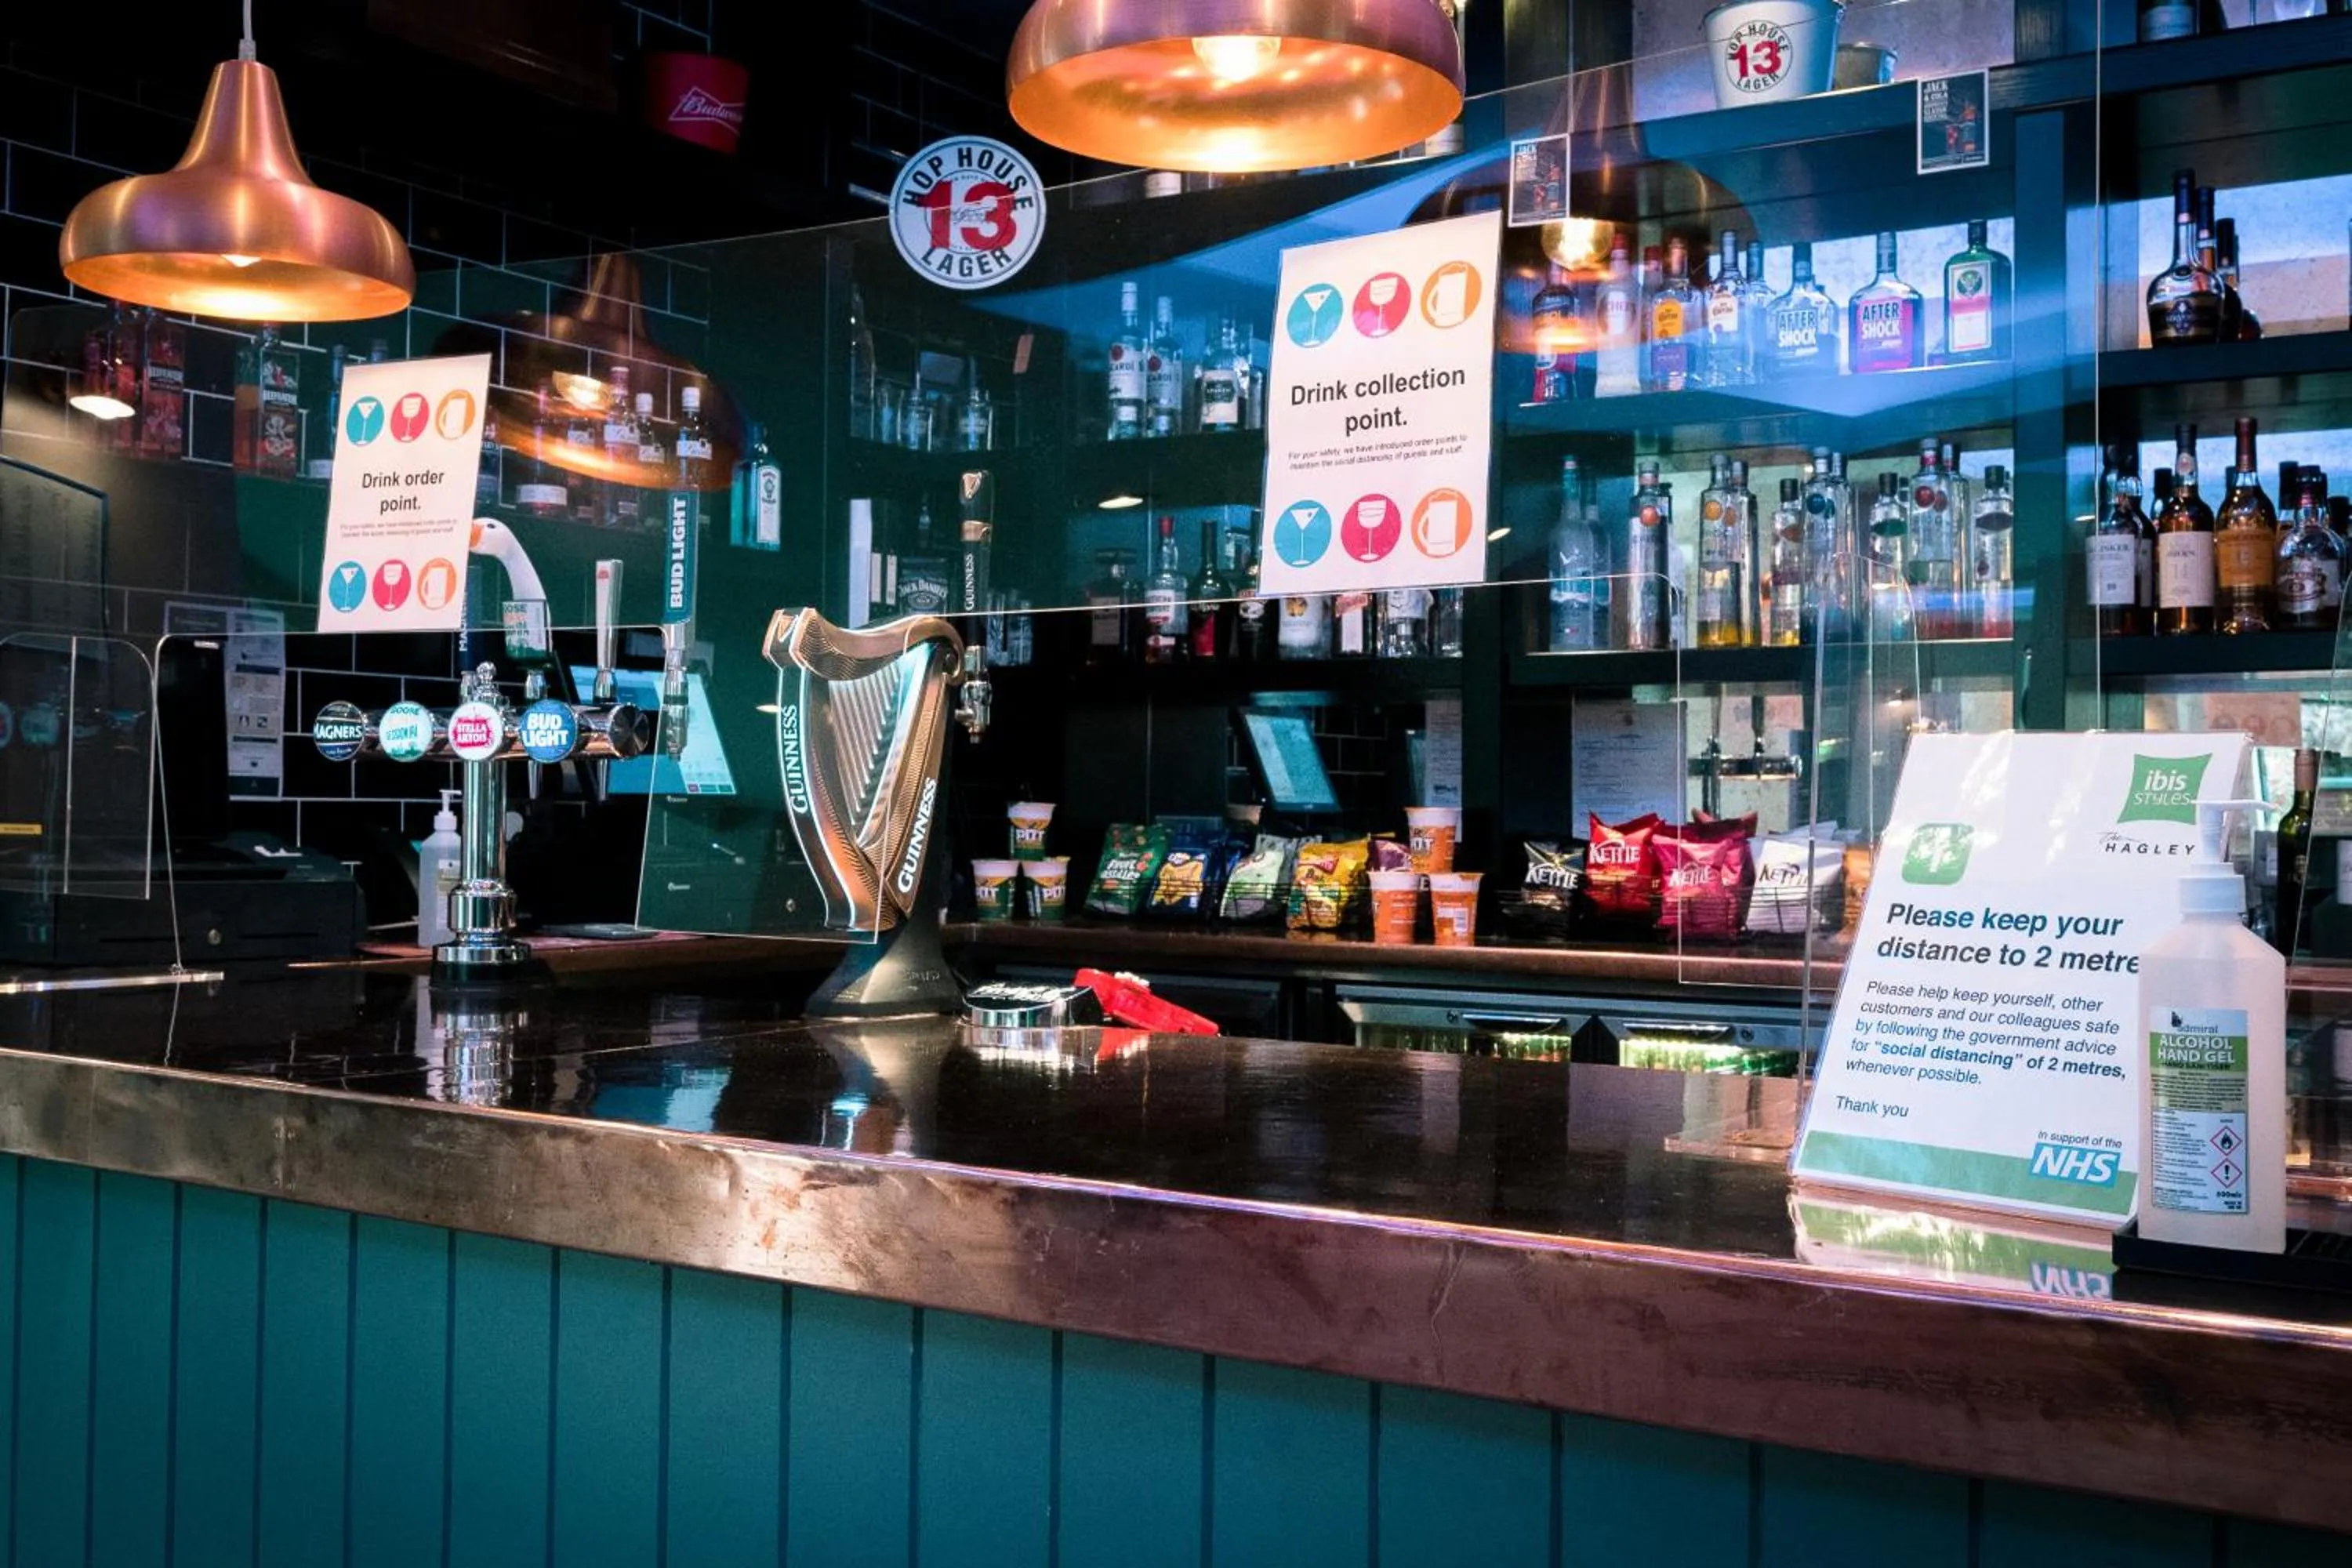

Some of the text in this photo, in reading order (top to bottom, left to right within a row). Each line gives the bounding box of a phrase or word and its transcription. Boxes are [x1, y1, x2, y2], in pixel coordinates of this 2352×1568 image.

[1734, 41, 1781, 77] 13
[903, 147, 1033, 211] HOP HOUSE
[916, 180, 1017, 251] 13
[921, 248, 1012, 278] LAGER
[1779, 311, 1817, 330] AFTER
[1863, 301, 1900, 321] AFTER
[1778, 328, 1817, 348] SHOCK
[1861, 319, 1900, 339] SHOCK
[1291, 368, 1465, 405] Drink collection
[1345, 406, 1407, 437] point.
[361, 470, 445, 489] Drink order
[379, 495, 421, 515] point.
[670, 497, 686, 608] BUD LIGHT
[964, 553, 975, 612] GUINNESS
[458, 722, 487, 733] STELLA
[527, 713, 562, 730] BUD
[523, 729, 568, 747] LIGHT
[782, 704, 808, 814] GUINNESS
[2145, 769, 2187, 791] ibis
[898, 777, 937, 893] GUINNESS
[1589, 841, 1641, 864] KETTLE
[2106, 843, 2195, 855] HAGLEY
[1526, 862, 1579, 889] KETTLE
[1886, 902, 2124, 939] Please keep your
[1877, 937, 2139, 974] distance to 2 metre
[1866, 981, 2103, 1012] Please help keep yourself, other
[1860, 1001, 2120, 1034] customers and our colleagues safe
[1855, 1018, 2117, 1055] by following the government advice
[2160, 1035, 2234, 1050] ALCOHOL
[1851, 1037, 1870, 1051] for
[2027, 1056, 2045, 1069] of
[2048, 1057, 2059, 1071] 2
[2063, 1061, 2125, 1081] metres,
[2157, 1047, 2236, 1064] HAND GEL
[1846, 1058, 1982, 1085] whenever possible.
[1835, 1095, 1910, 1118] Thank you
[2050, 1132, 2089, 1145] support
[2092, 1136, 2103, 1146] of
[2105, 1138, 2122, 1149] the
[2031, 1146, 2118, 1183] NHS
